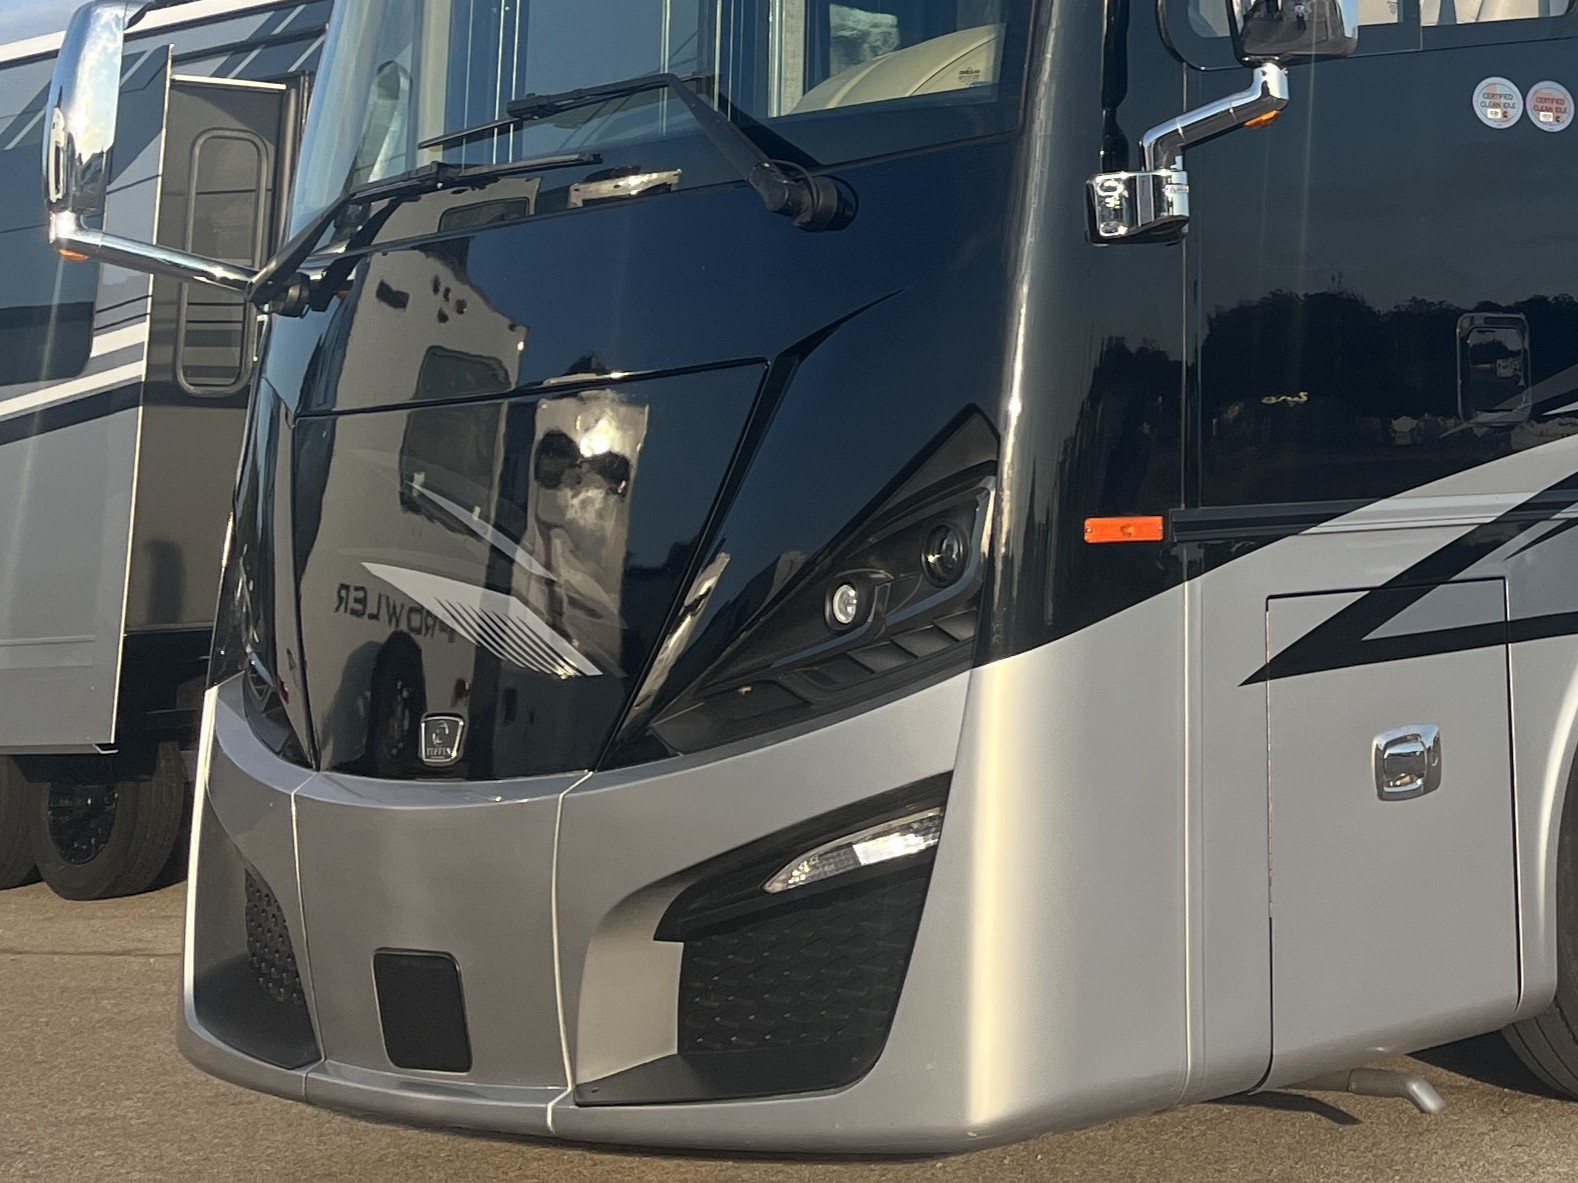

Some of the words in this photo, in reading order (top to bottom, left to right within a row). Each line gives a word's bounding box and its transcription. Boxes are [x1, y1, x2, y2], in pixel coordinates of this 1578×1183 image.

[1482, 93, 1514, 101] CERTIFIED
[1535, 97, 1565, 106] CERTIFIED
[1480, 100, 1501, 109] CLEAN
[1533, 104, 1554, 113] CLEAN
[1555, 106, 1567, 114] IDLE
